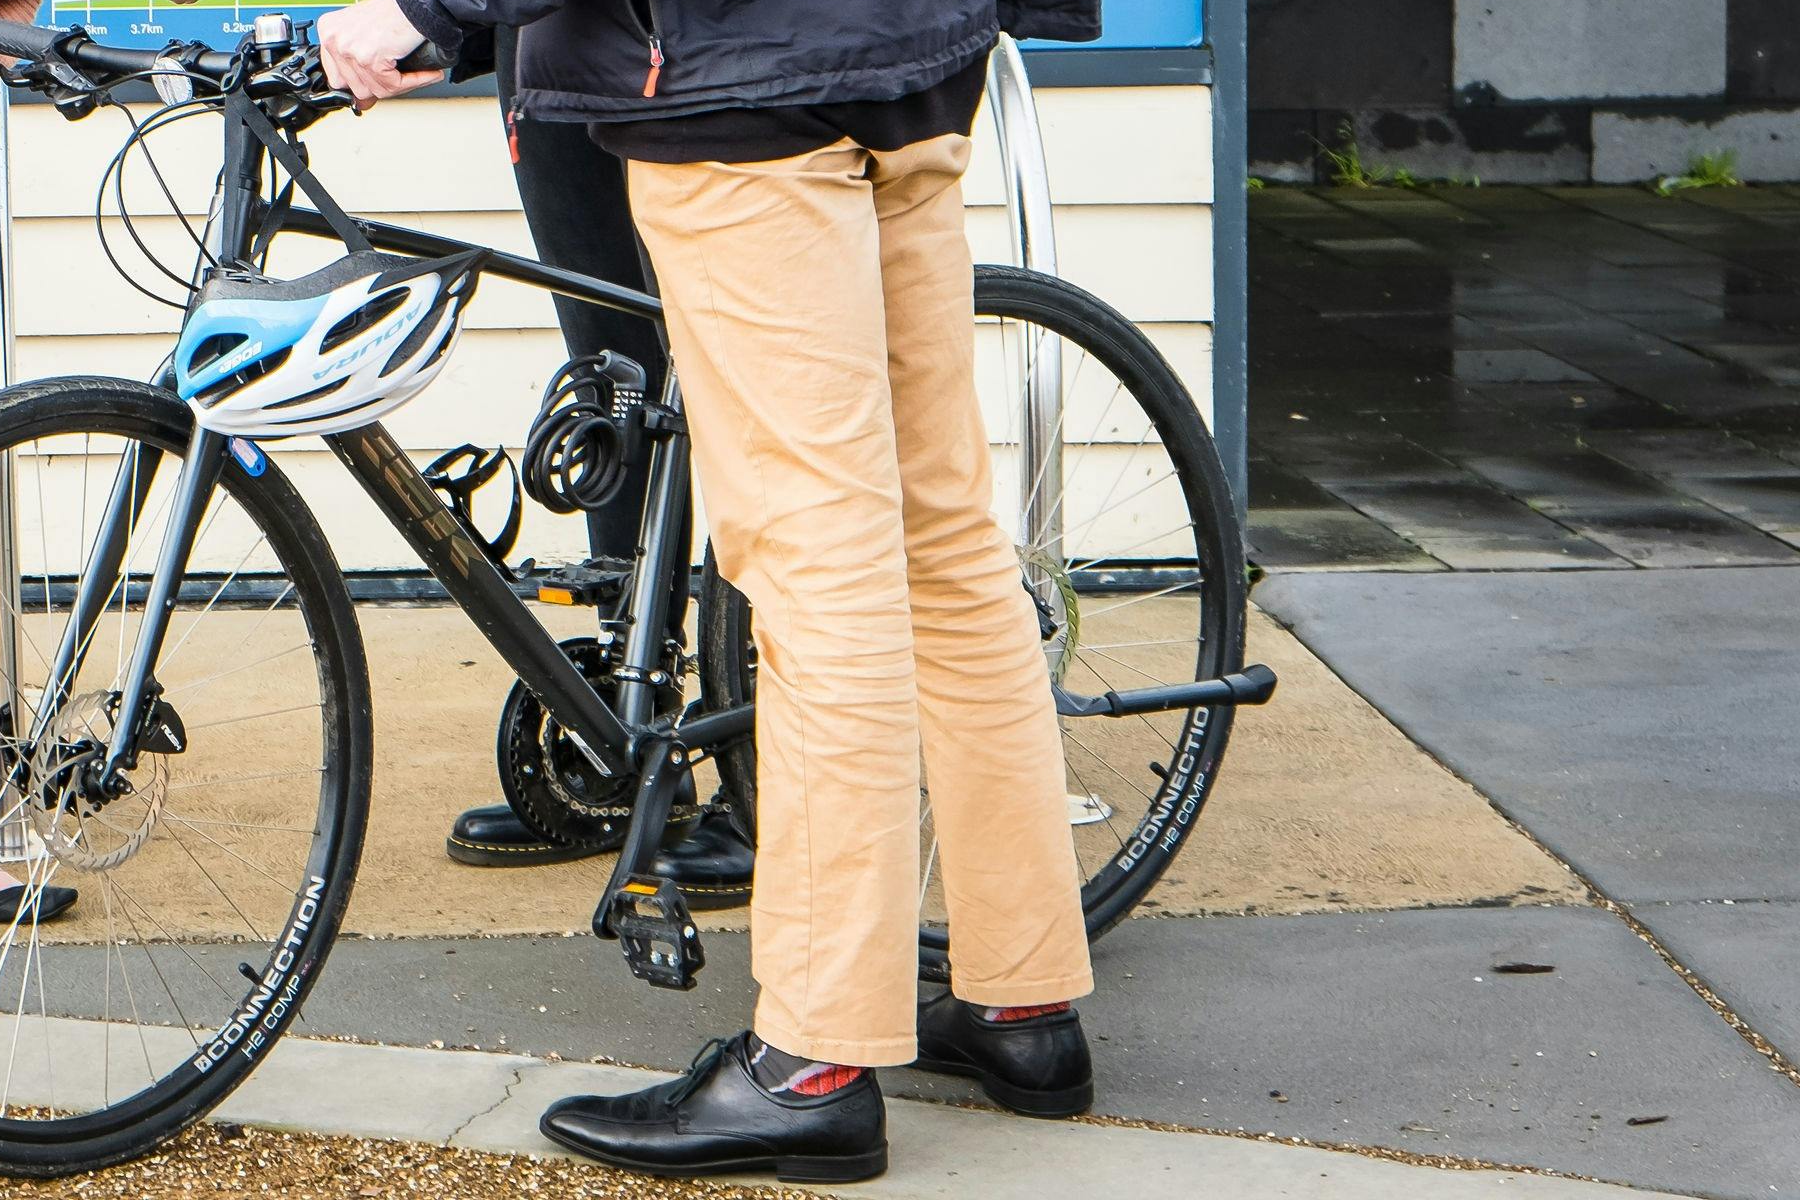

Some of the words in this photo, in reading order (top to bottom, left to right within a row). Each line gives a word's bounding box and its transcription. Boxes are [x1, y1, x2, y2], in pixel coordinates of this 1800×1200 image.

[130, 23, 164, 35] 3.7km
[1128, 706, 1210, 862] CONNECTIO
[207, 875, 326, 1061] CONNECTION
[263, 974, 301, 1030] COMP
